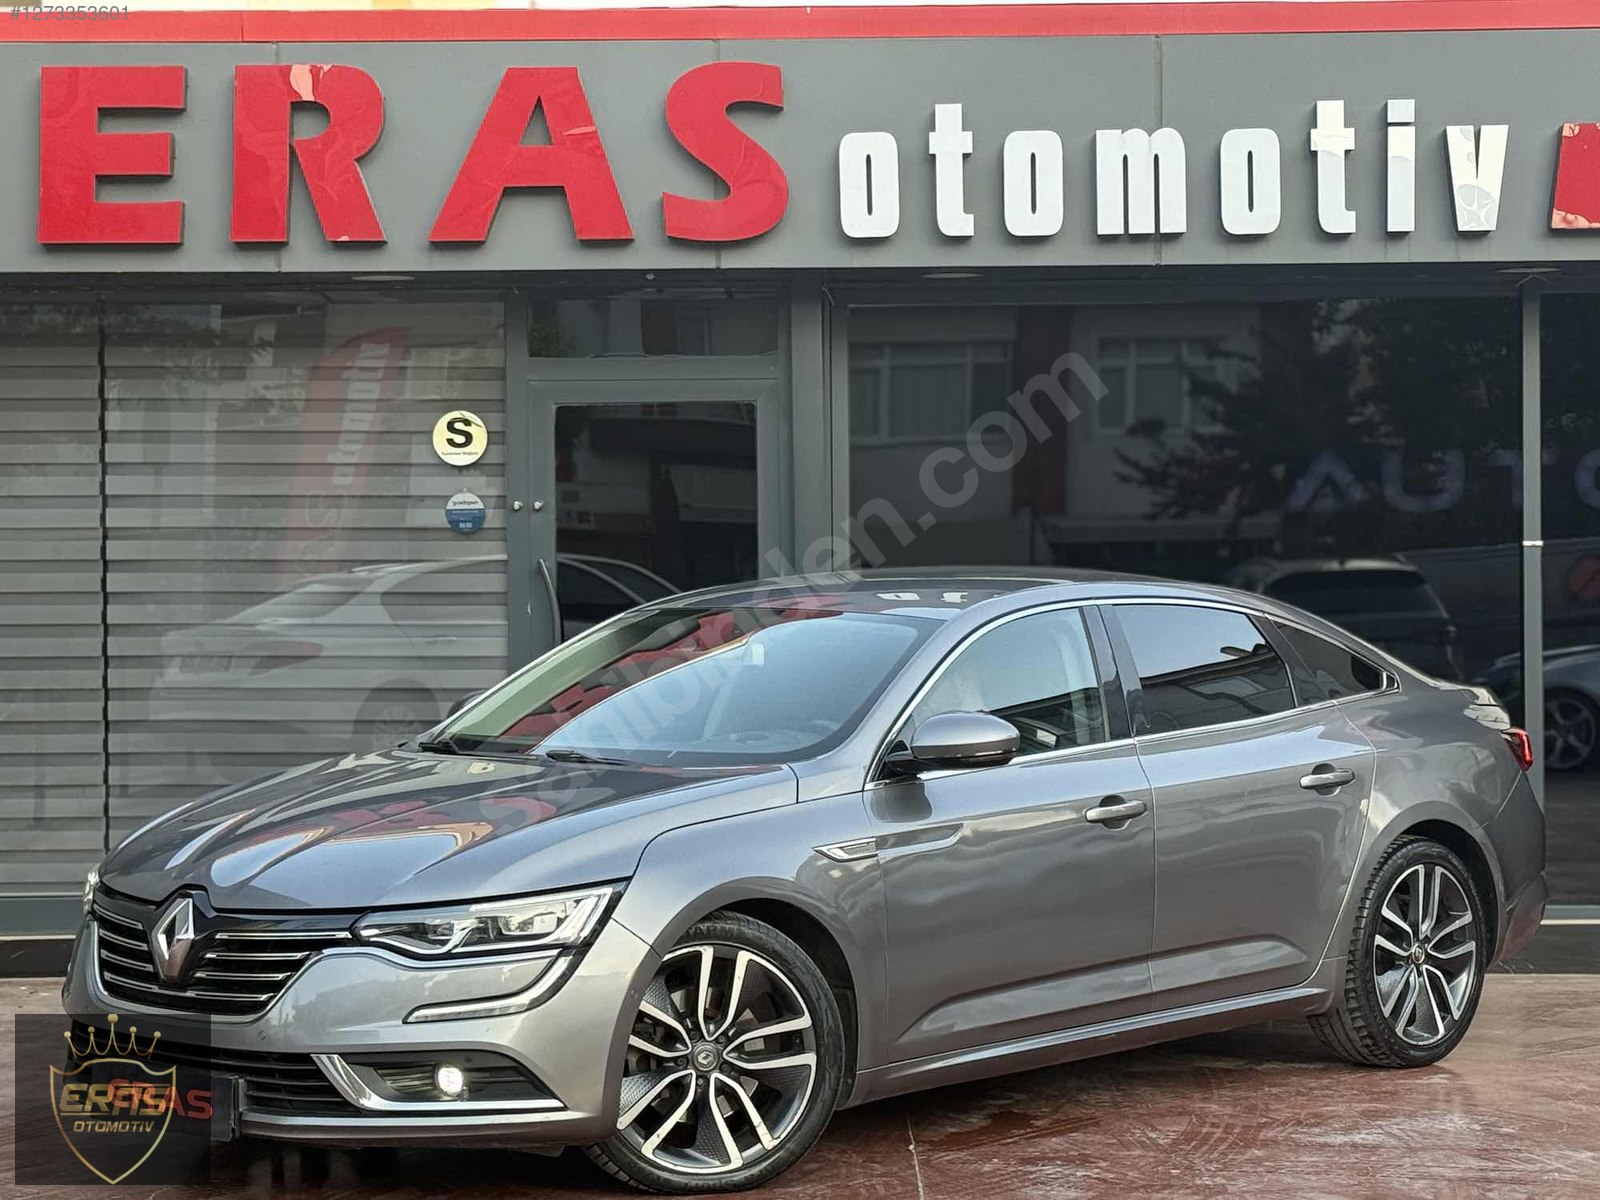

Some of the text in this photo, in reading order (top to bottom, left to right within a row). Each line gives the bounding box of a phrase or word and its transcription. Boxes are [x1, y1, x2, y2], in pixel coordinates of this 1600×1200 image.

[39, 61, 1509, 245] ERAS otomotiv
[446, 417, 473, 448] S
[1286, 449, 1600, 512] AUT
